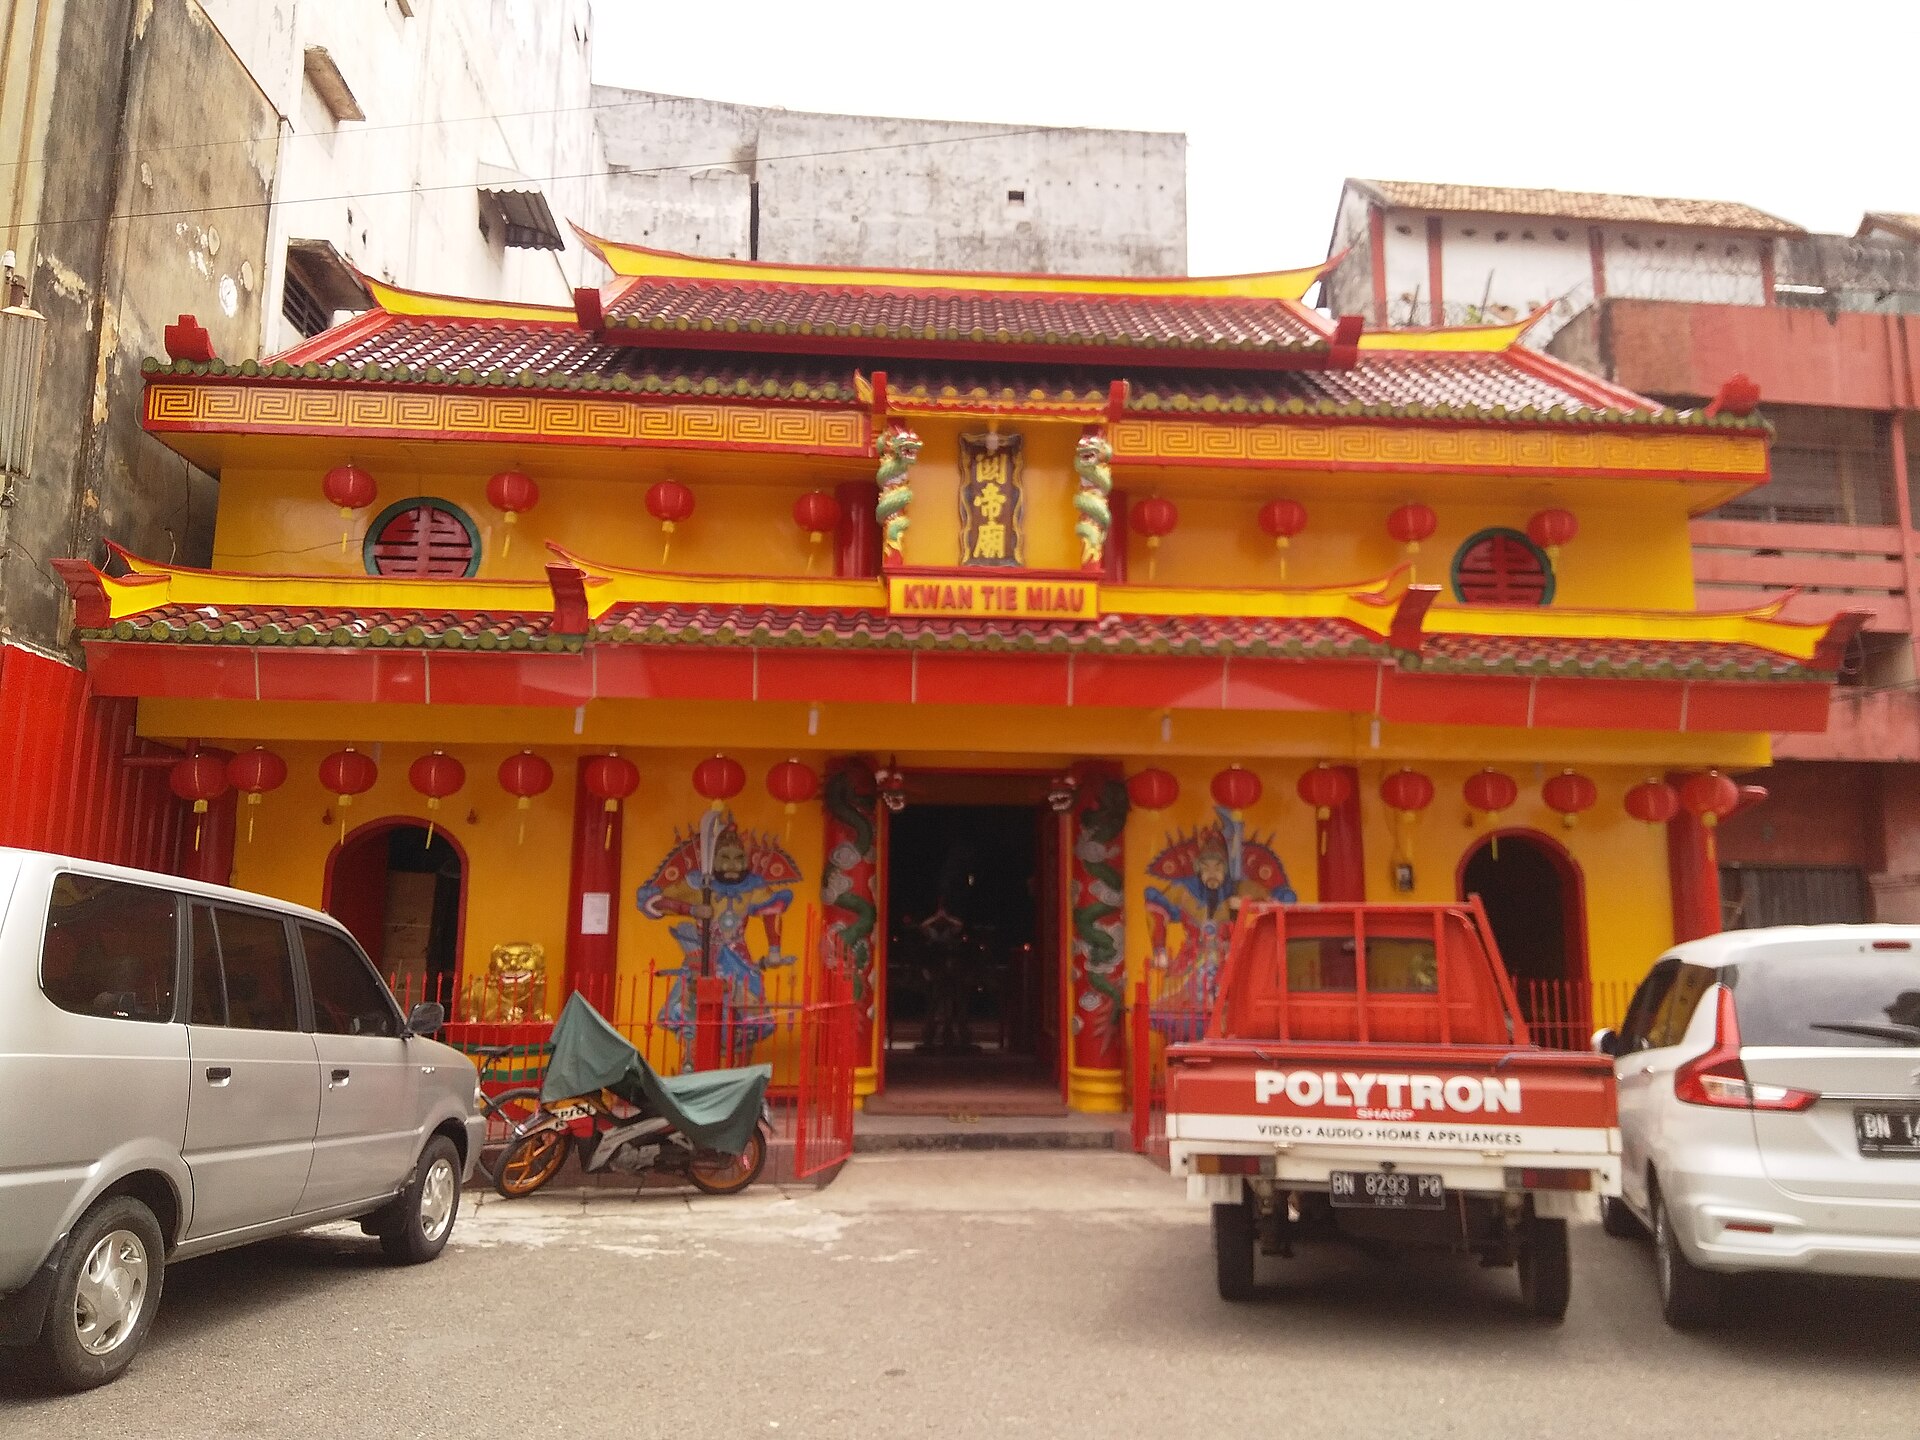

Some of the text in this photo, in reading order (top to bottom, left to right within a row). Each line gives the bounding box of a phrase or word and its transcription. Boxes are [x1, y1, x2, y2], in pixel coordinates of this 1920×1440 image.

[904, 583, 1085, 613] KWAN TIE MIAU
[1255, 1069, 1522, 1114] POLYTRON
[1356, 1107, 1416, 1120] SHARP
[1863, 1113, 1891, 1139] BN
[1257, 1124, 1522, 1145] VIDEO AUDIO HOME APPLIANCES
[1332, 1172, 1355, 1196] BN
[1365, 1173, 1410, 1197] 8293
